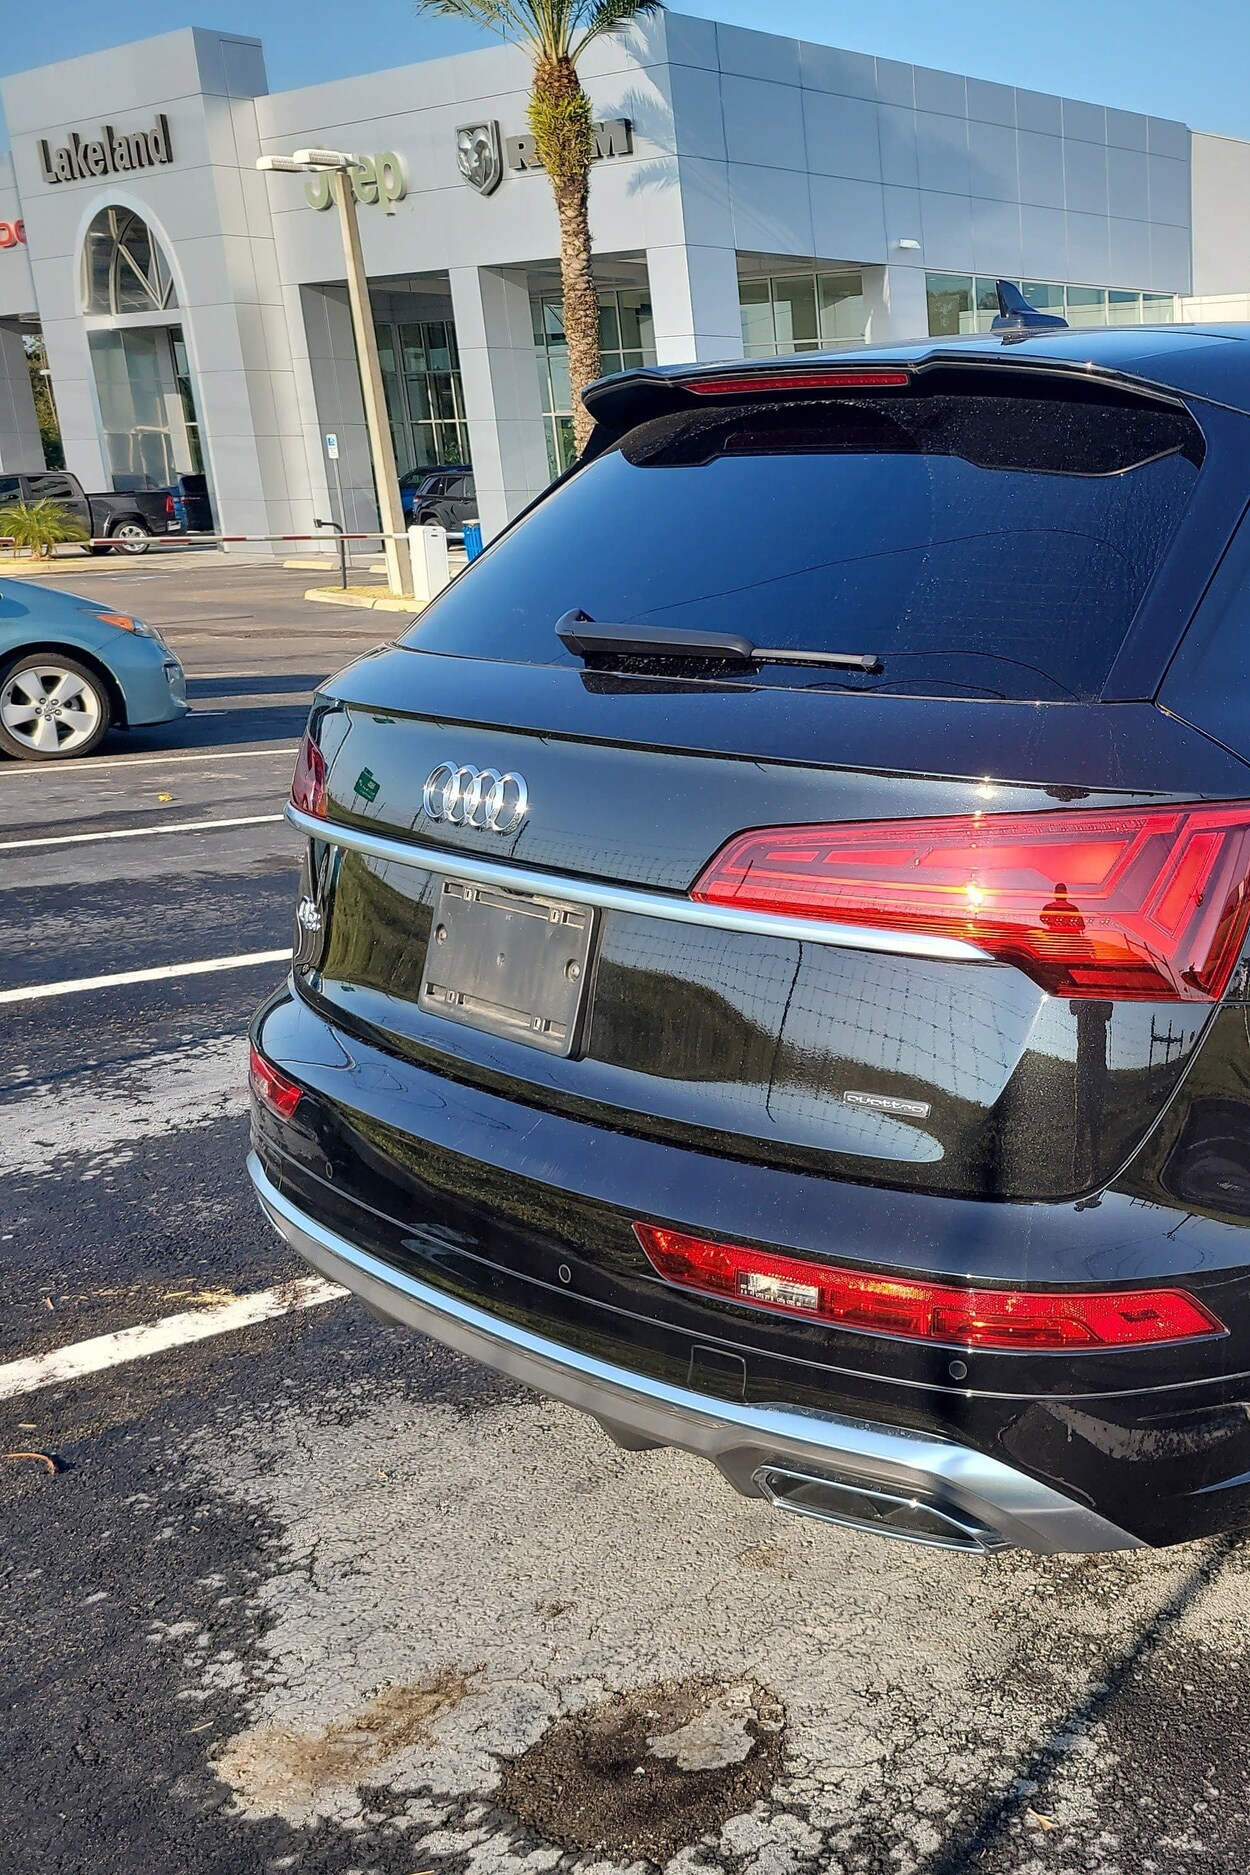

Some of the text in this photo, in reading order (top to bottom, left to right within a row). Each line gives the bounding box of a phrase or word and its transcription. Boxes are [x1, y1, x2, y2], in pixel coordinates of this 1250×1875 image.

[38, 114, 173, 183] Lakeland
[506, 118, 634, 170] RM
[304, 152, 406, 215] Jep
